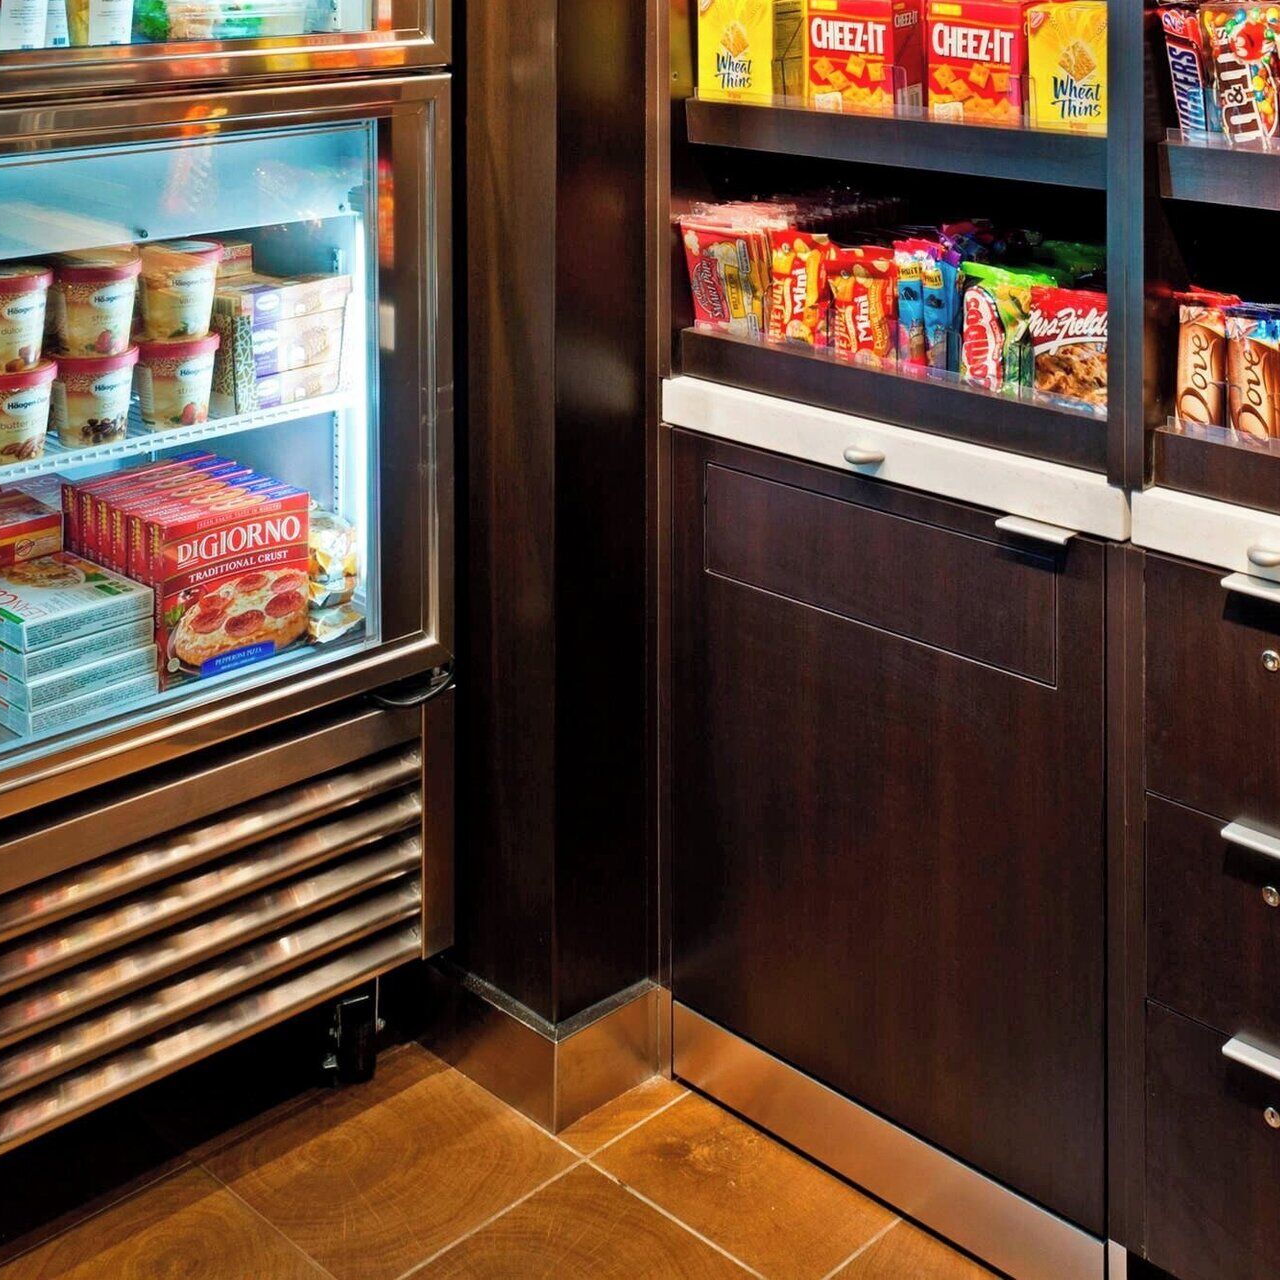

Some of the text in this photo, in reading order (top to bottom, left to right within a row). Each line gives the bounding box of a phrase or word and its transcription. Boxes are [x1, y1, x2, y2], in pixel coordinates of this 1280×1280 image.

[810, 17, 886, 56] CHEEZ-IT
[931, 22, 1015, 63] CHEEZ-IT
[715, 52, 752, 74] Wheat
[716, 71, 753, 90] Thins
[1051, 97, 1102, 119] Thins
[1052, 76, 1101, 101] Wheat
[791, 267, 808, 315] Mini
[854, 294, 873, 343] Mini
[1177, 333, 1211, 430] Dove
[1230, 348, 1270, 442] Dove
[188, 550, 289, 583] TRADITIONAL CRUST
